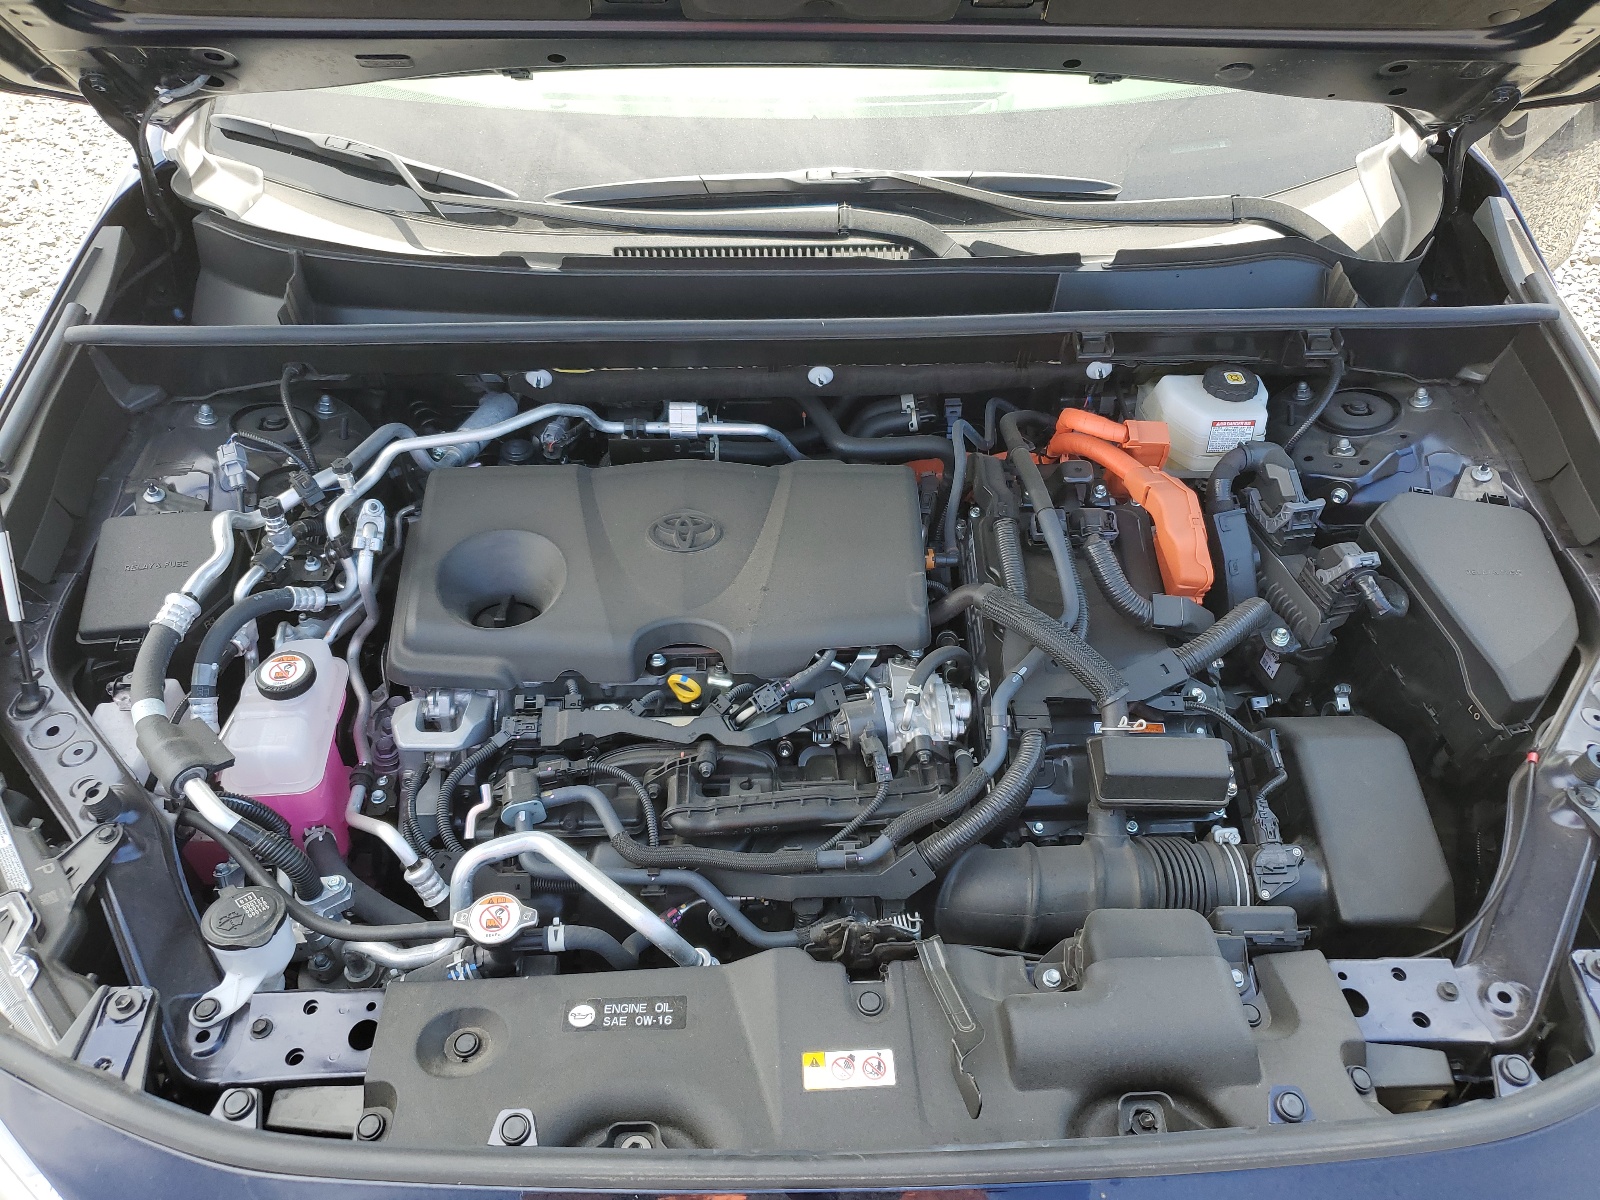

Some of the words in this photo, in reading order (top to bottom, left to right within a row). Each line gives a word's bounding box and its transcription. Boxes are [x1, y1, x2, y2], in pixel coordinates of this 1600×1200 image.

[125, 562, 154, 571] RELAY
[164, 560, 189, 569] FUSE
[604, 1003, 647, 1014] ENGINE
[655, 1002, 673, 1013] OIL
[603, 1016, 628, 1026] SAE
